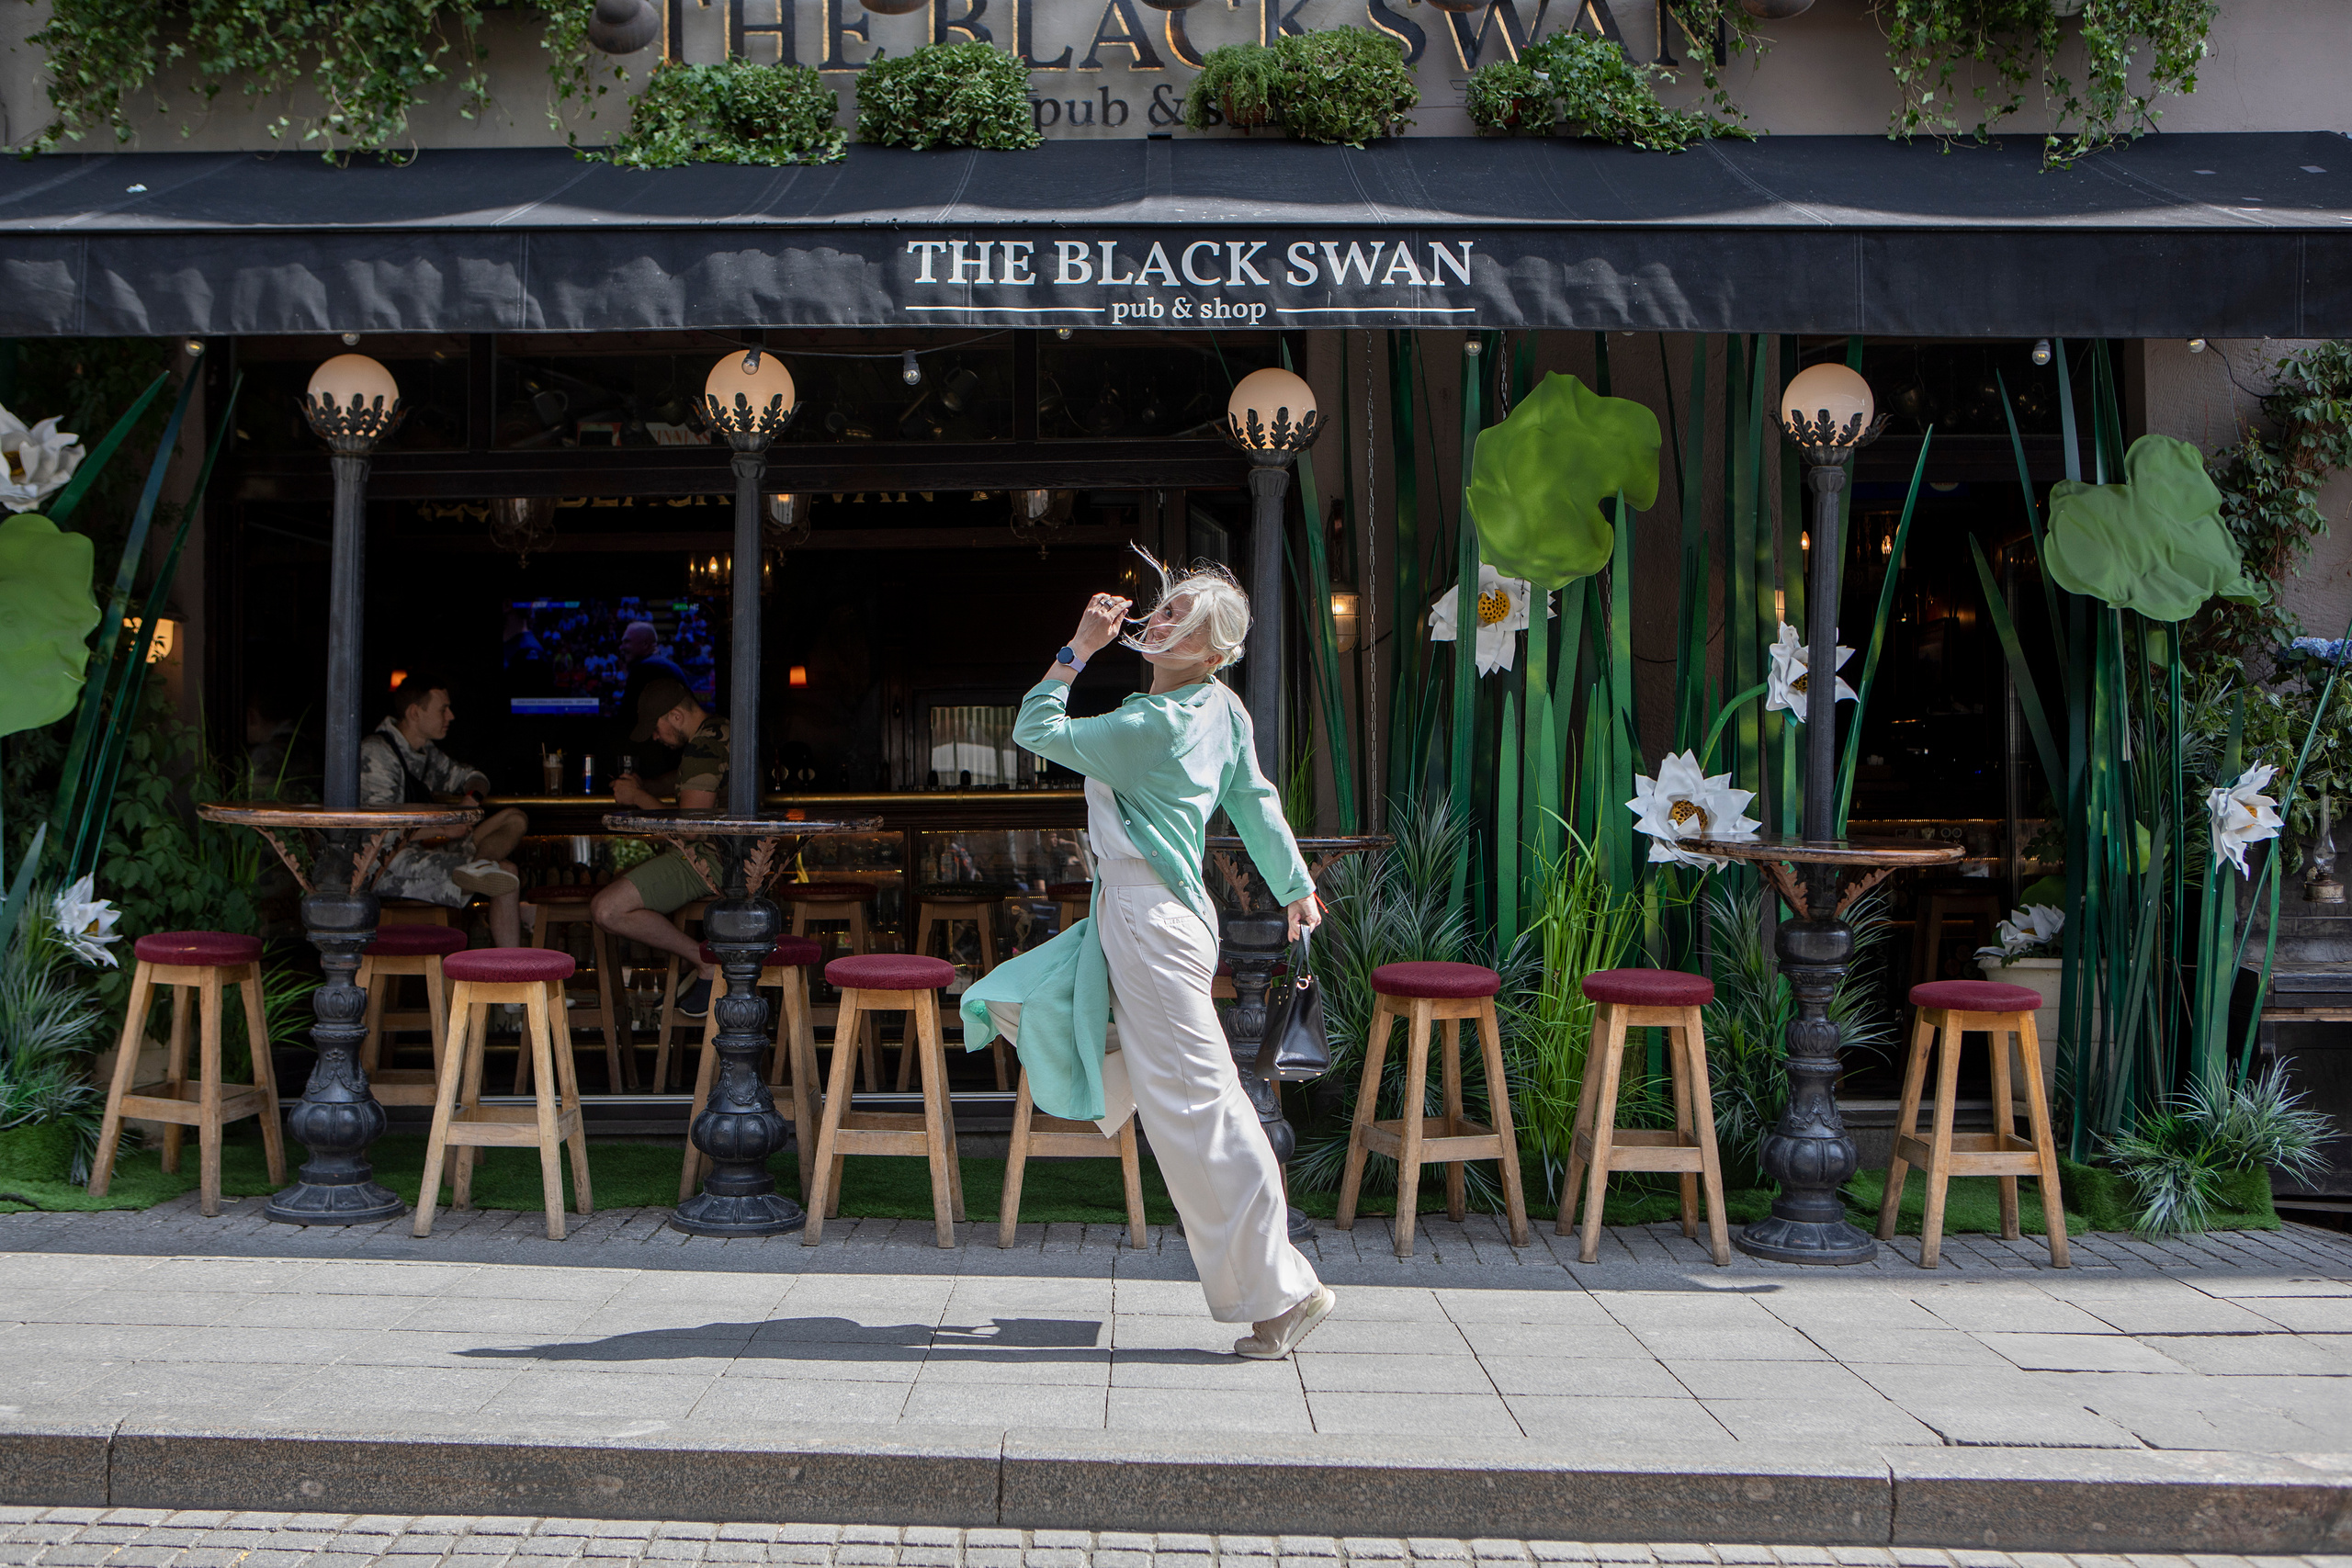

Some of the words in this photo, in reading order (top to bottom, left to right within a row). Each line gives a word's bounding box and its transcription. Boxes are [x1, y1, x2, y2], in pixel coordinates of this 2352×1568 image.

[656, 0, 886, 73] THE
[1029, 85, 1129, 138] pub
[1148, 84, 1186, 128] &
[906, 241, 1036, 285] THE
[1054, 241, 1270, 286] BLACK
[1286, 241, 1474, 286] SWAN
[1112, 297, 1164, 325] pub
[1171, 297, 1193, 320] &
[1200, 298, 1267, 325] shop
